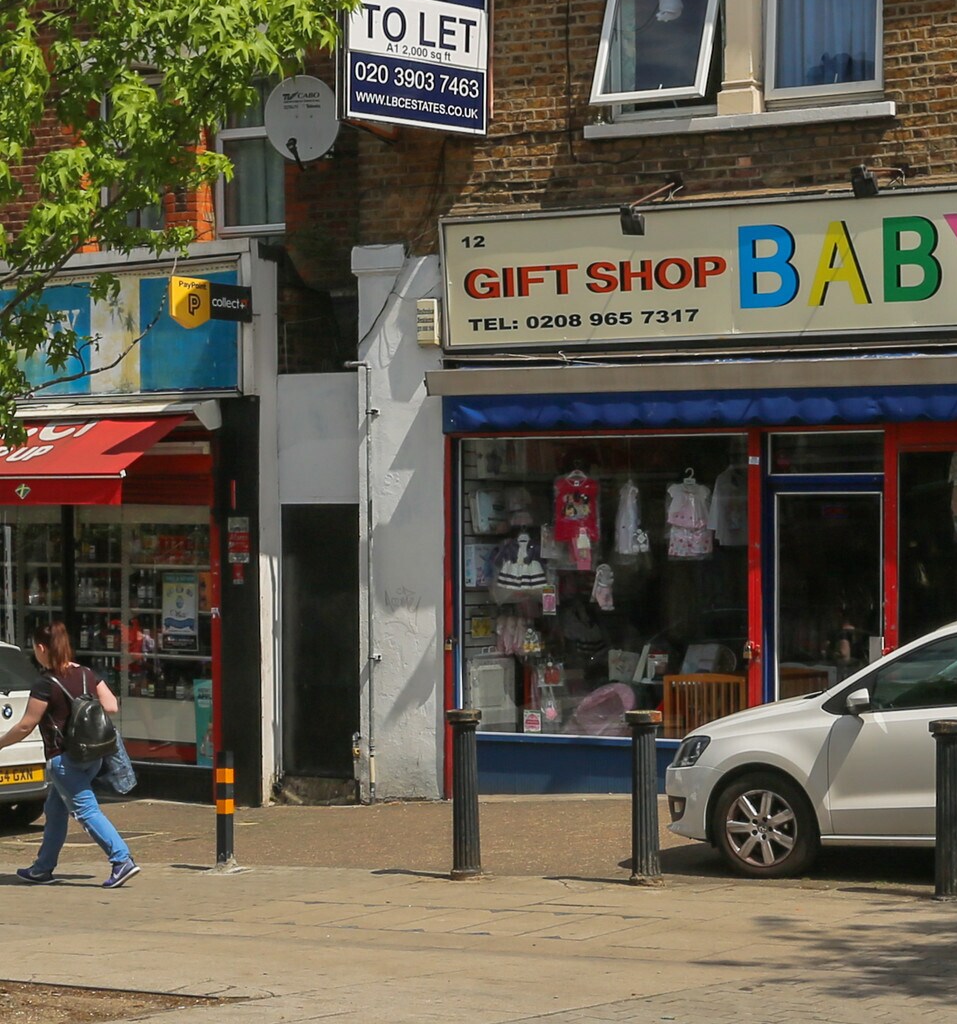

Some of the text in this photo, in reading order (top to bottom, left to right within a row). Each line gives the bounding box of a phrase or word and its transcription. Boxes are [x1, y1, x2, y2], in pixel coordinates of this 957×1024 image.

[363, 3, 477, 54] TO LET
[386, 43, 451, 63] A1 2,000 sq ft
[355, 61, 480, 98] 020 3903 7463
[356, 91, 479, 119] WWW.LBCESTATES.CO.UK
[461, 235, 486, 248] 12
[179, 280, 207, 290] PayPoint
[464, 255, 727, 299] GIFT SHOP
[468, 309, 699, 331] TEL: 0208 965 7317
